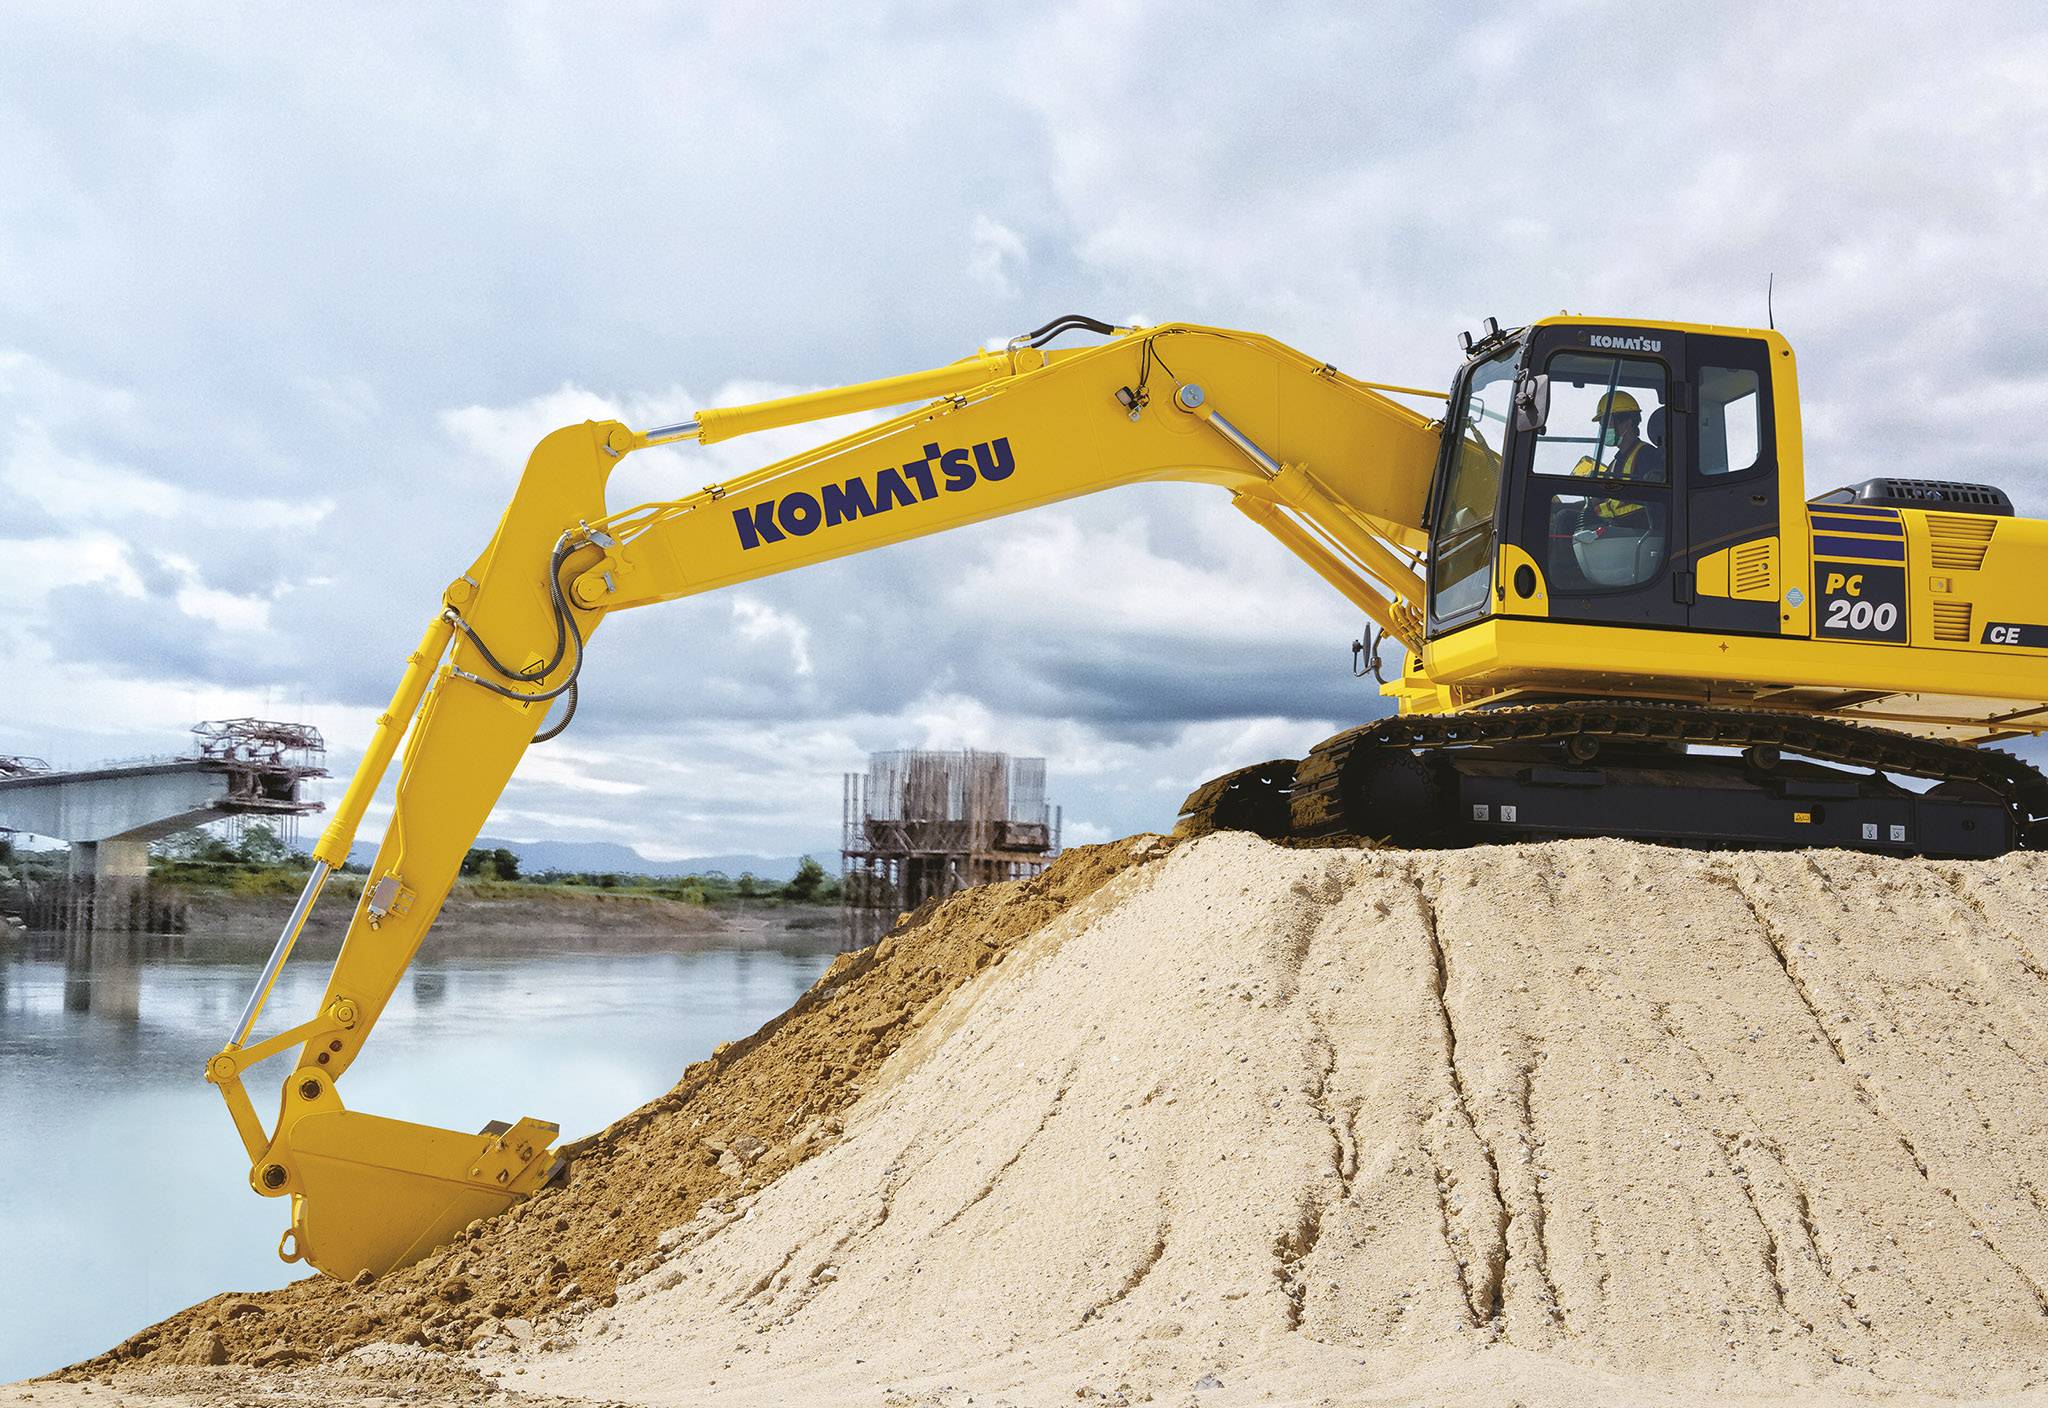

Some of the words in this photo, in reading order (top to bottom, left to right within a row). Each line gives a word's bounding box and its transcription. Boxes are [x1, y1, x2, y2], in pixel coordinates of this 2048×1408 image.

[1590, 334, 1662, 352] KOMATSU
[732, 437, 1016, 550] KOMATSU
[1825, 573, 1864, 597] PC
[1824, 599, 1898, 632] 200
[1990, 626, 2021, 644] CE
